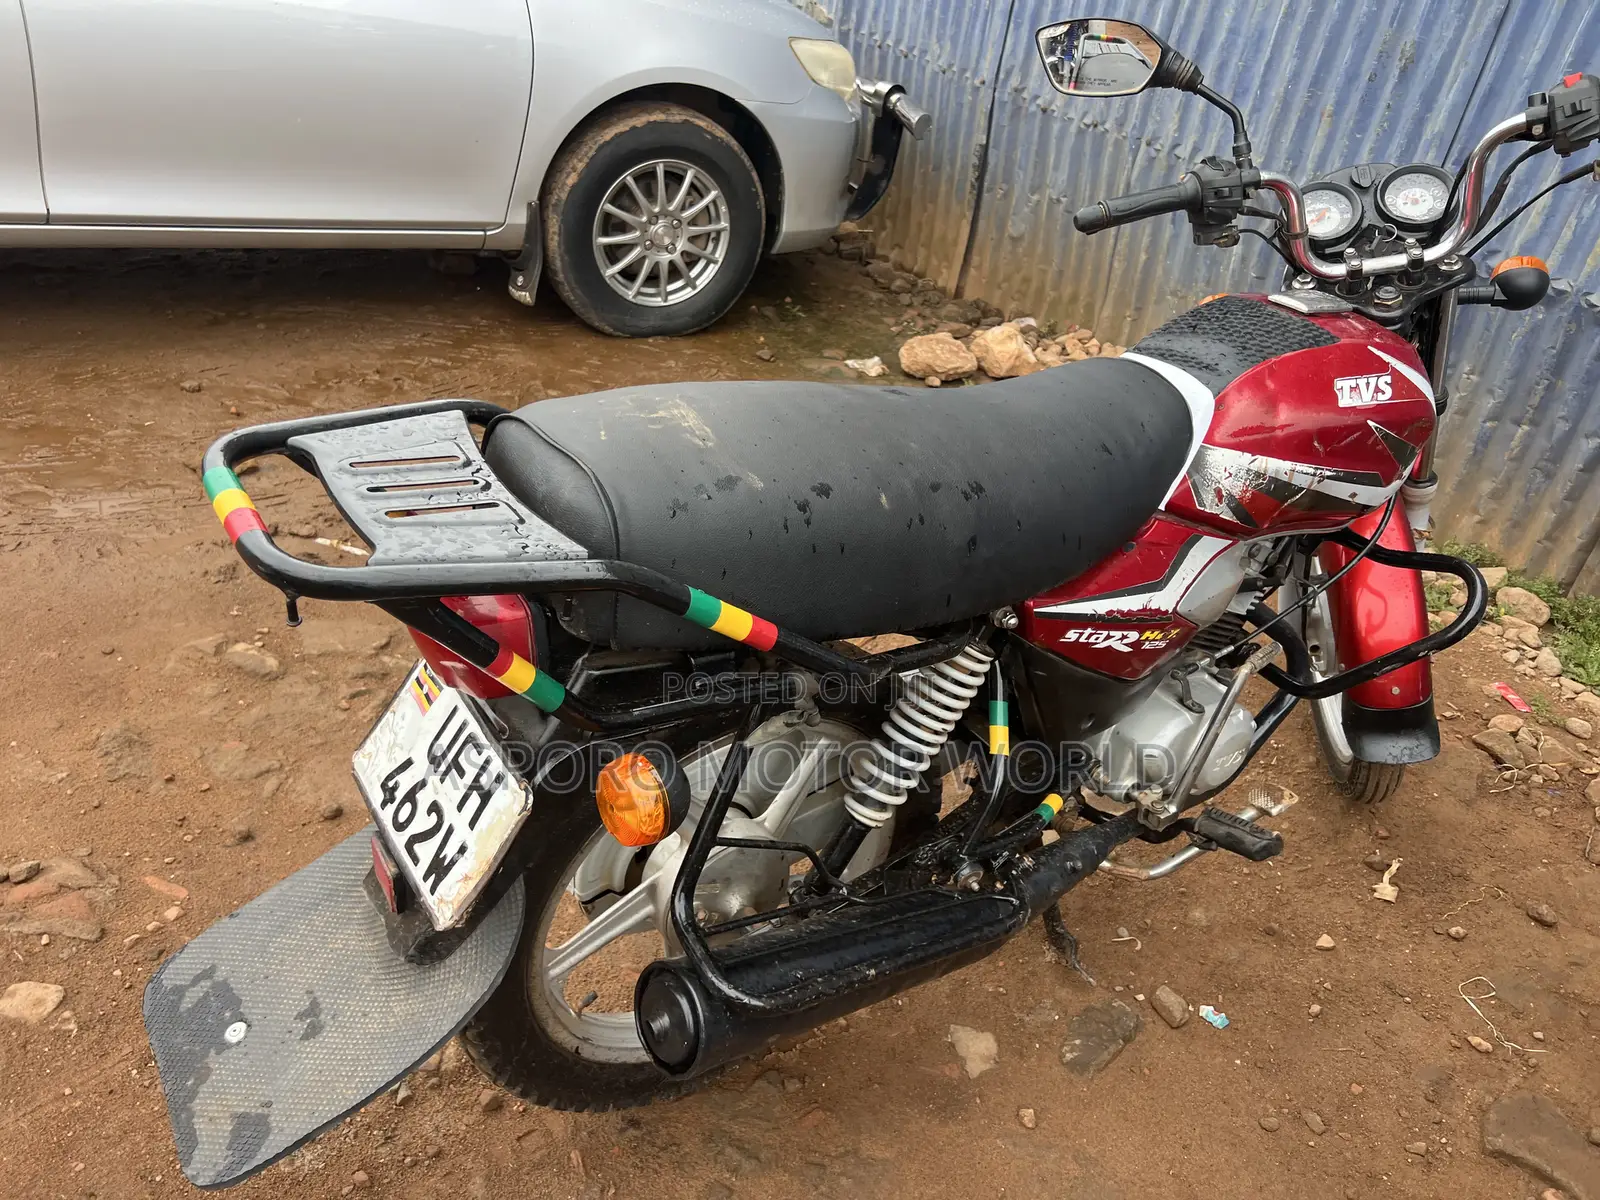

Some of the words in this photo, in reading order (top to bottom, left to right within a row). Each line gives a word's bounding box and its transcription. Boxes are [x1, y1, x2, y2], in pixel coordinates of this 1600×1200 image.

[1336, 375, 1393, 406] TVS
[1140, 640, 1169, 650] 125
[427, 704, 506, 831] UFH
[380, 756, 468, 896] 462W
